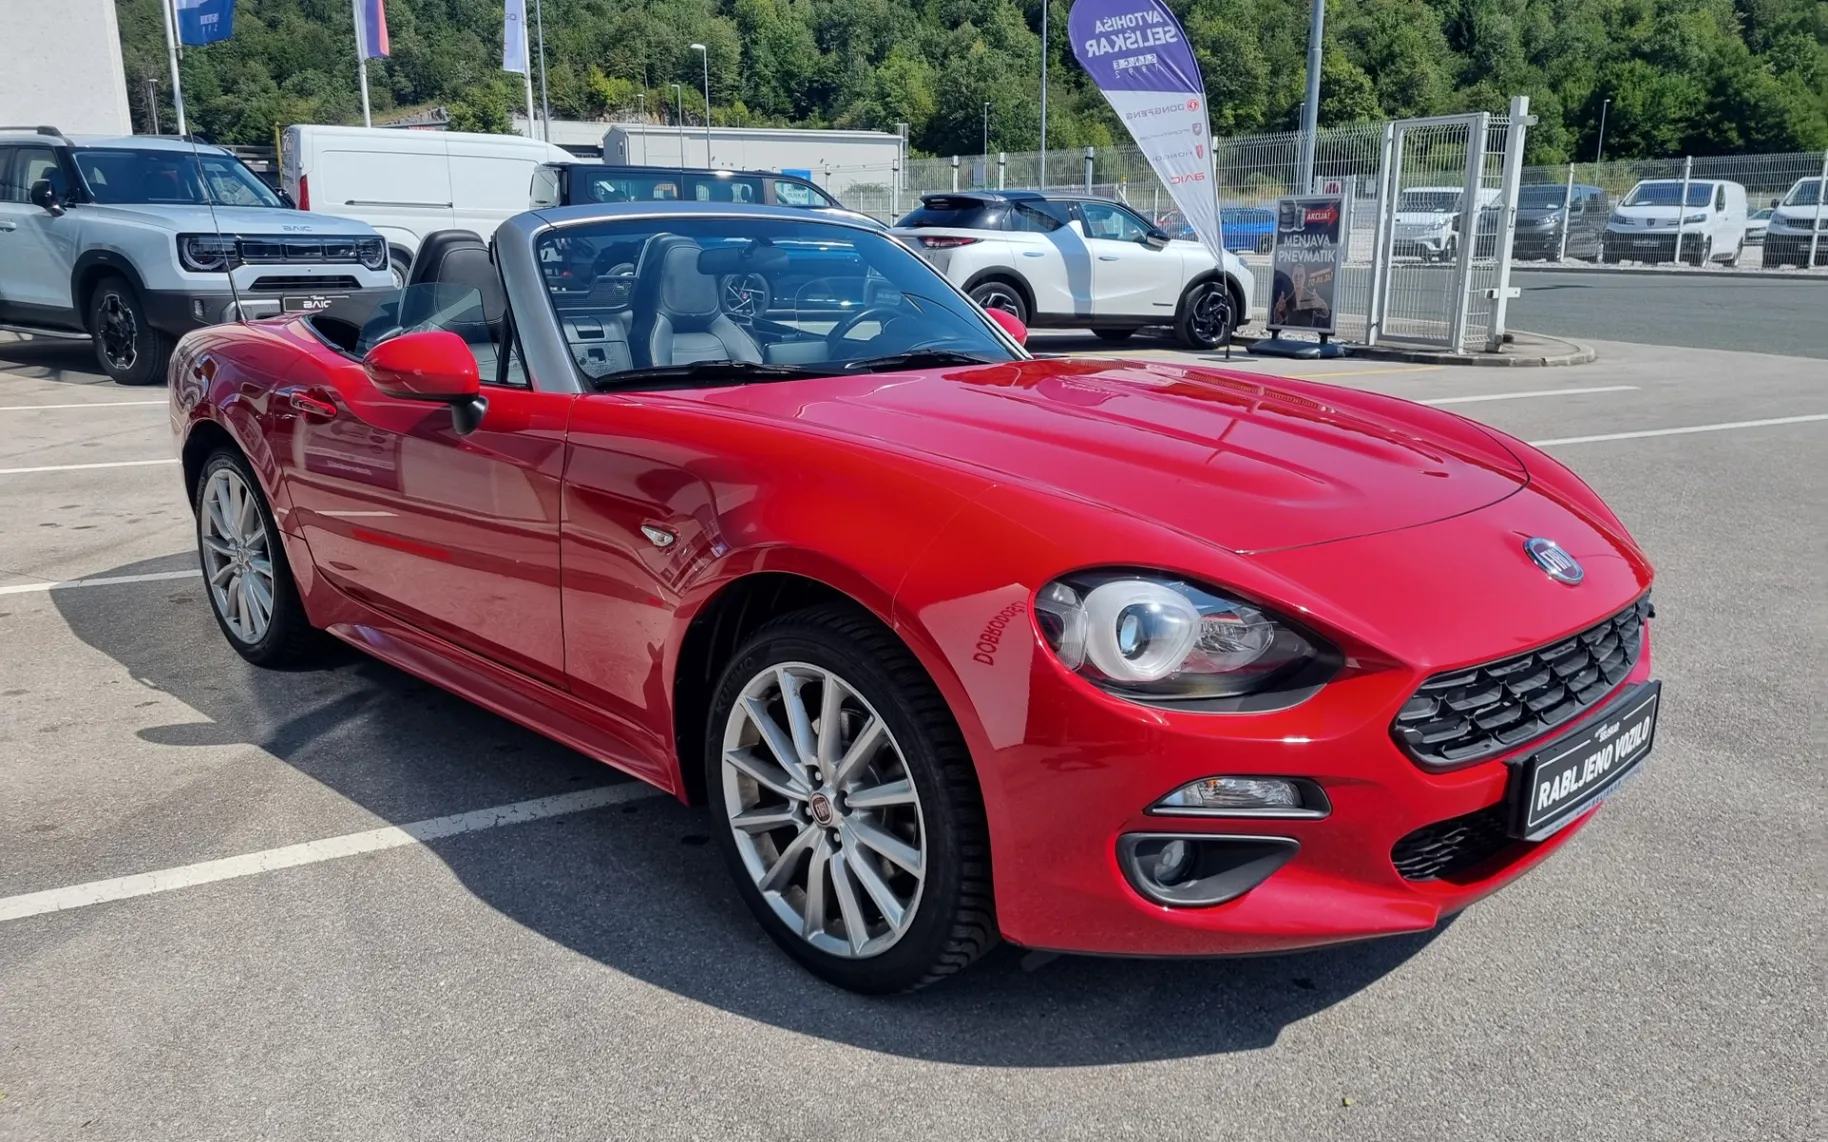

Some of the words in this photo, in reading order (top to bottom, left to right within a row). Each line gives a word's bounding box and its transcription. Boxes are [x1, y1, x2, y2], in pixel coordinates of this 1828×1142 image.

[1284, 234, 1331, 248] MENJAVA
[1278, 250, 1336, 263] PNEVMATIK
[303, 300, 332, 309] BAIC
[1537, 743, 1614, 811] RABLJENO
[1615, 716, 1650, 763] VOZILO
